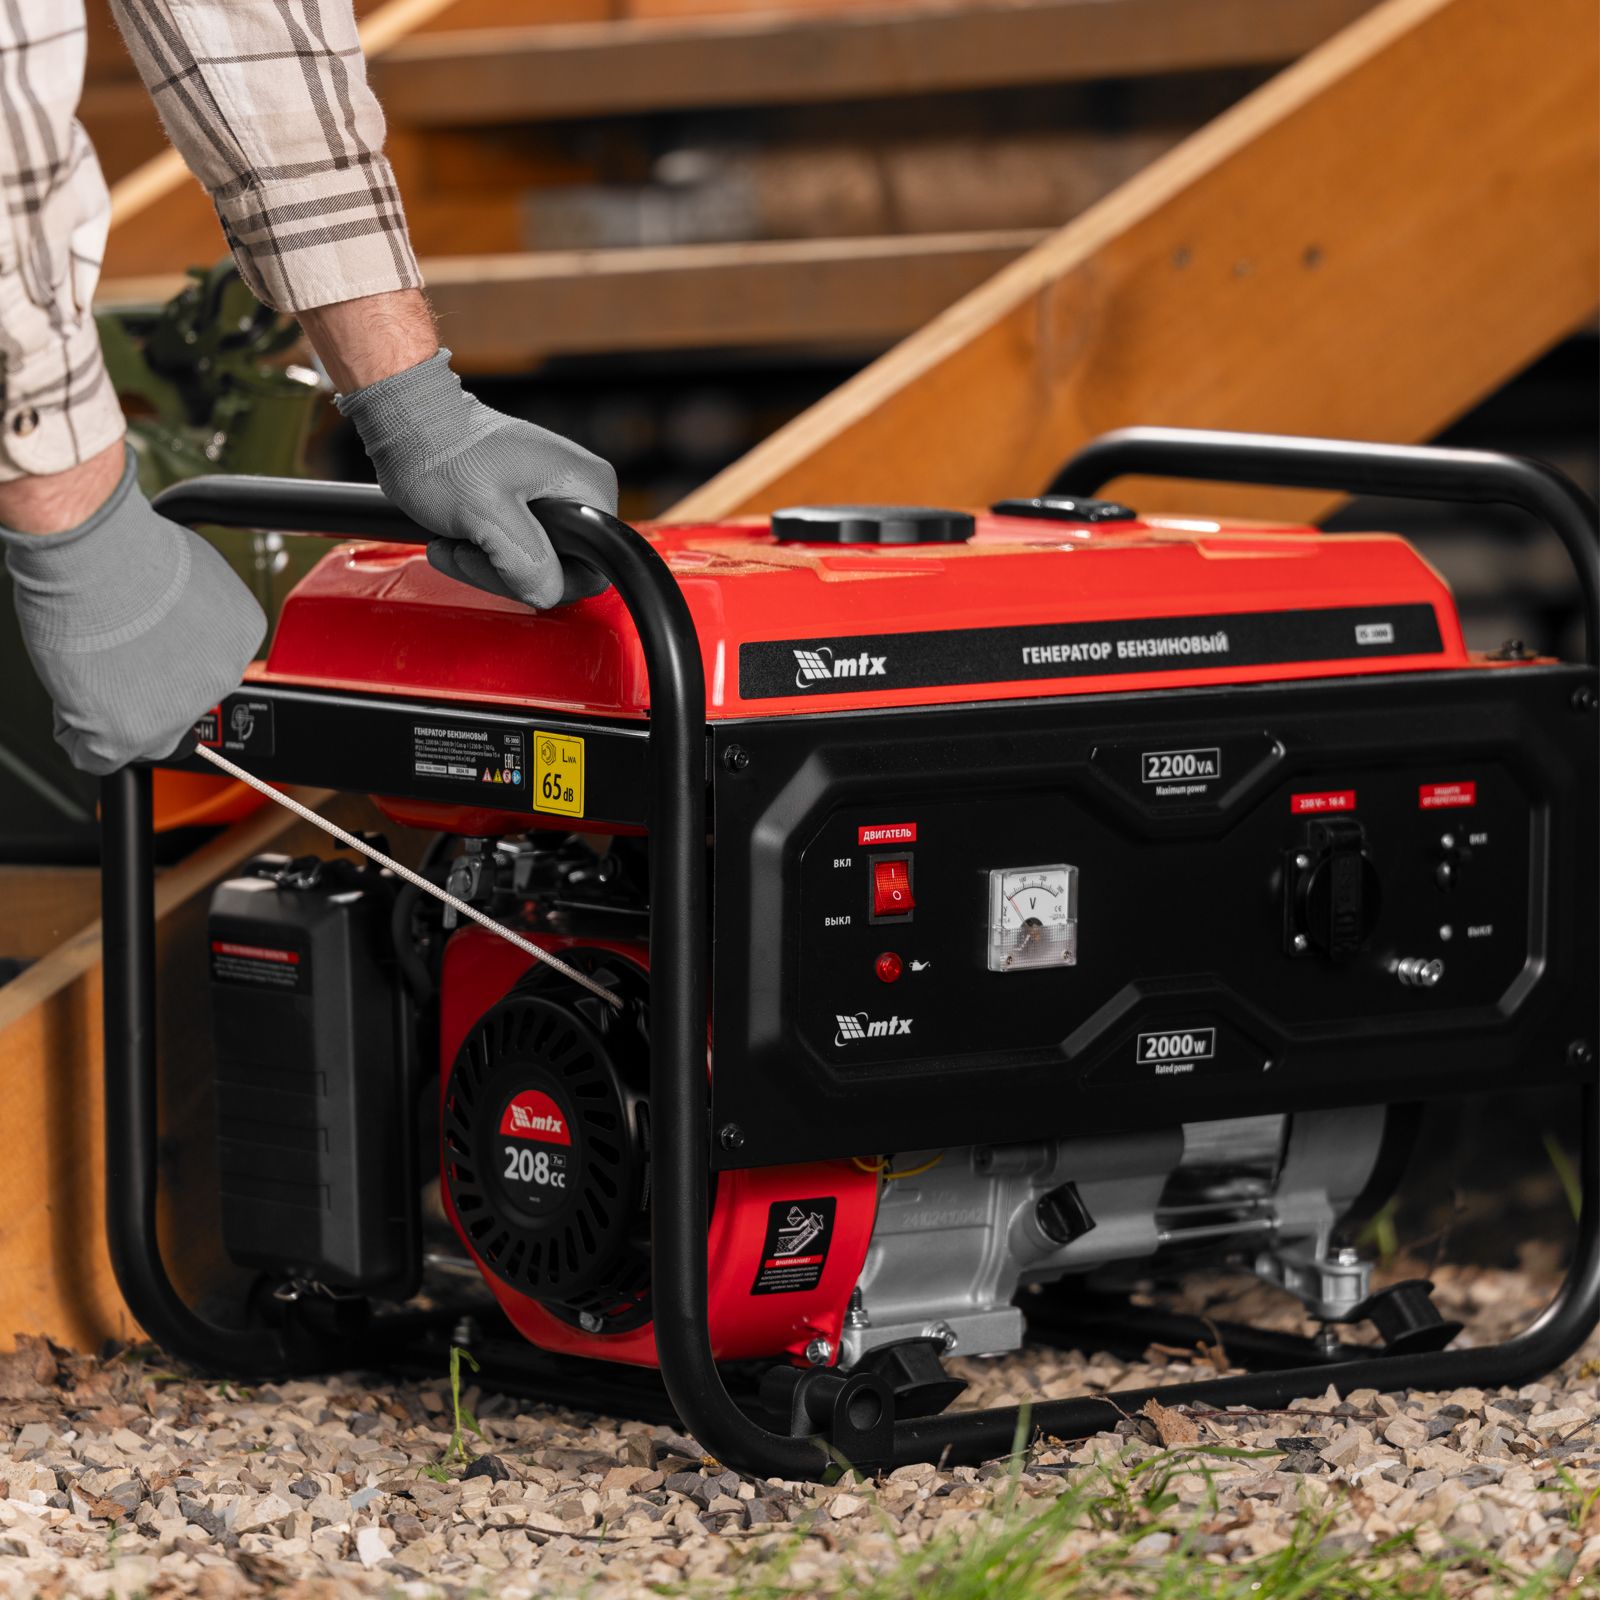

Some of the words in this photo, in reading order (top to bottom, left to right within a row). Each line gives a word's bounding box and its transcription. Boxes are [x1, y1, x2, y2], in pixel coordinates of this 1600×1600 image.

[1022, 642, 1112, 664] ГЕНЕРАТОР
[1117, 631, 1228, 658] БЕНЗИНОВЫЙ
[833, 652, 887, 678] mtx
[414, 726, 447, 738] ГЕНЕРАТОР
[447, 729, 488, 742] БЕНЗИНОВЫЙ
[1156, 785, 1186, 796] Maximum
[1186, 784, 1208, 796] power
[863, 828, 912, 842] ДВИГАТЕЛЬ
[833, 858, 851, 868] ВКЛ
[1030, 897, 1036, 910] V
[825, 916, 851, 926] ВЫКЛ
[867, 1016, 913, 1038] mtx
[1155, 1064, 1173, 1074] Rated
[1174, 1063, 1194, 1075] power
[532, 1115, 562, 1133] mtx
[776, 1258, 810, 1266] ВНИМАНИЕ!
